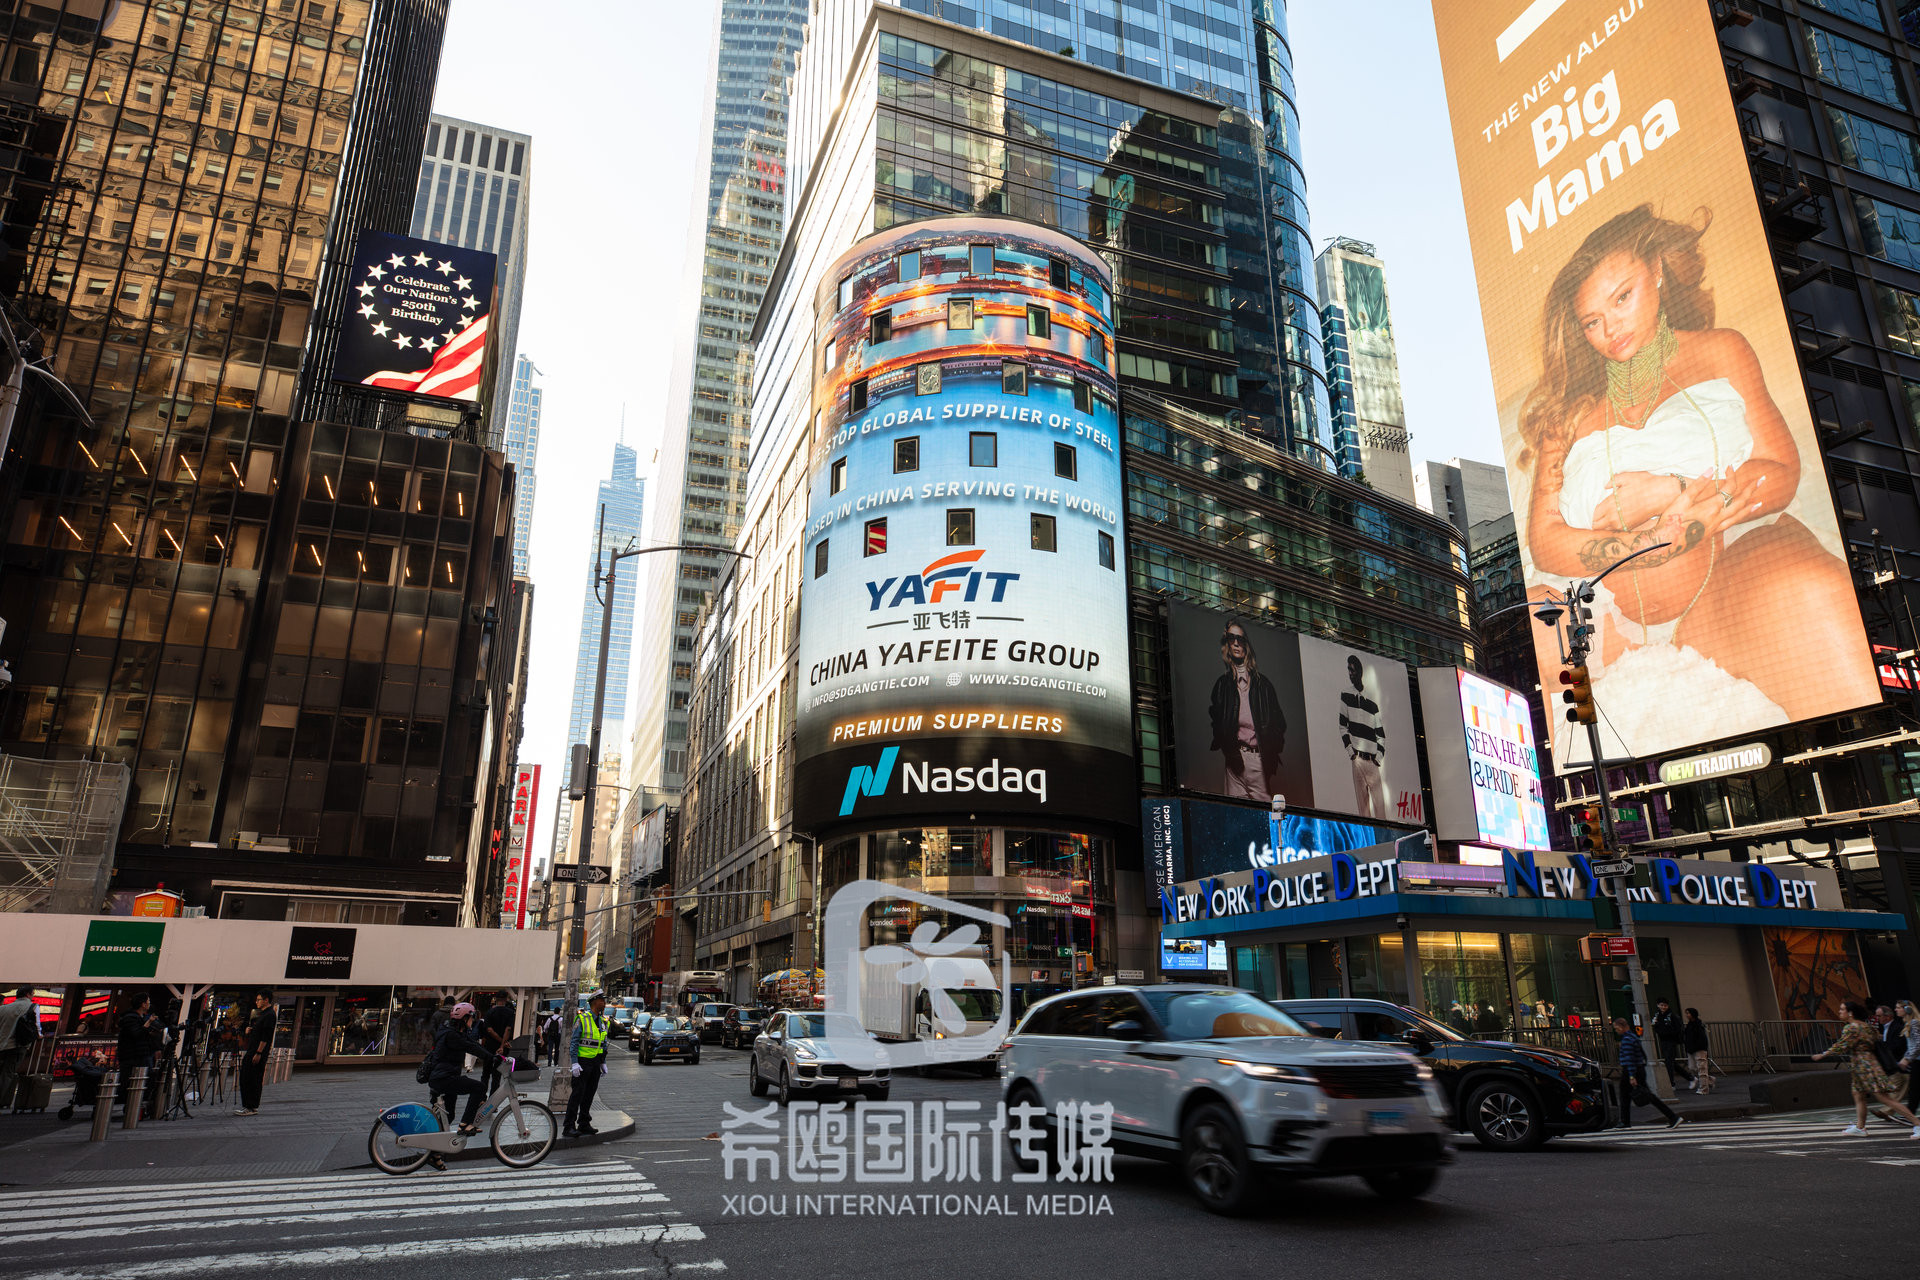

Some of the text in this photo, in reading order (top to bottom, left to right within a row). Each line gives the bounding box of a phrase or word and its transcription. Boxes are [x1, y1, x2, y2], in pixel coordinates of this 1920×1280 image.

[1482, 102, 1521, 143] THE
[1523, 54, 1571, 110] NEW
[1576, 0, 1644, 64] ALBU
[1530, 69, 1621, 169] Big
[1505, 98, 1680, 254] Mama
[383, 284, 457, 305] Our Nation's
[394, 275, 450, 292] Celebrate
[391, 307, 443, 325] Birthday
[401, 300, 436, 312] 250th
[860, 406, 935, 435] GLOBAL
[941, 403, 1043, 424] SUPPLIER
[1048, 413, 1072, 430] OF
[1075, 421, 1113, 452] STEEL
[806, 480, 1117, 545] BASED IN CHINA SERVING THE WORLD
[865, 550, 1020, 611] YAFIT
[912, 610, 970, 631] 亚飞特
[810, 639, 1100, 687] CHINA YAFEITE GROUP
[811, 673, 1107, 708] INFO@SDGANGTIE.COM WWW.SDGANGTIE.COM
[833, 712, 1063, 742] PREMIUM SUPPLIERS
[514, 772, 531, 826] PARK
[902, 758, 1047, 804] Nasdaq
[1163, 805, 1171, 826] (IGC)
[1397, 790, 1422, 822] H&M
[1153, 806, 1166, 899] NYSE AMERICAN
[1595, 862, 1629, 874] ONE WAY
[503, 858, 521, 913] PARK
[561, 869, 578, 878] ONE
[1161, 853, 1397, 925] NEW YORK POLICE DEPT
[1503, 848, 1576, 899] NEW
[1654, 858, 1750, 906] POLICE
[1750, 864, 1818, 909] DEPT
[1026, 906, 1046, 914] Nasdaq
[89, 945, 142, 953] STARBUCKS
